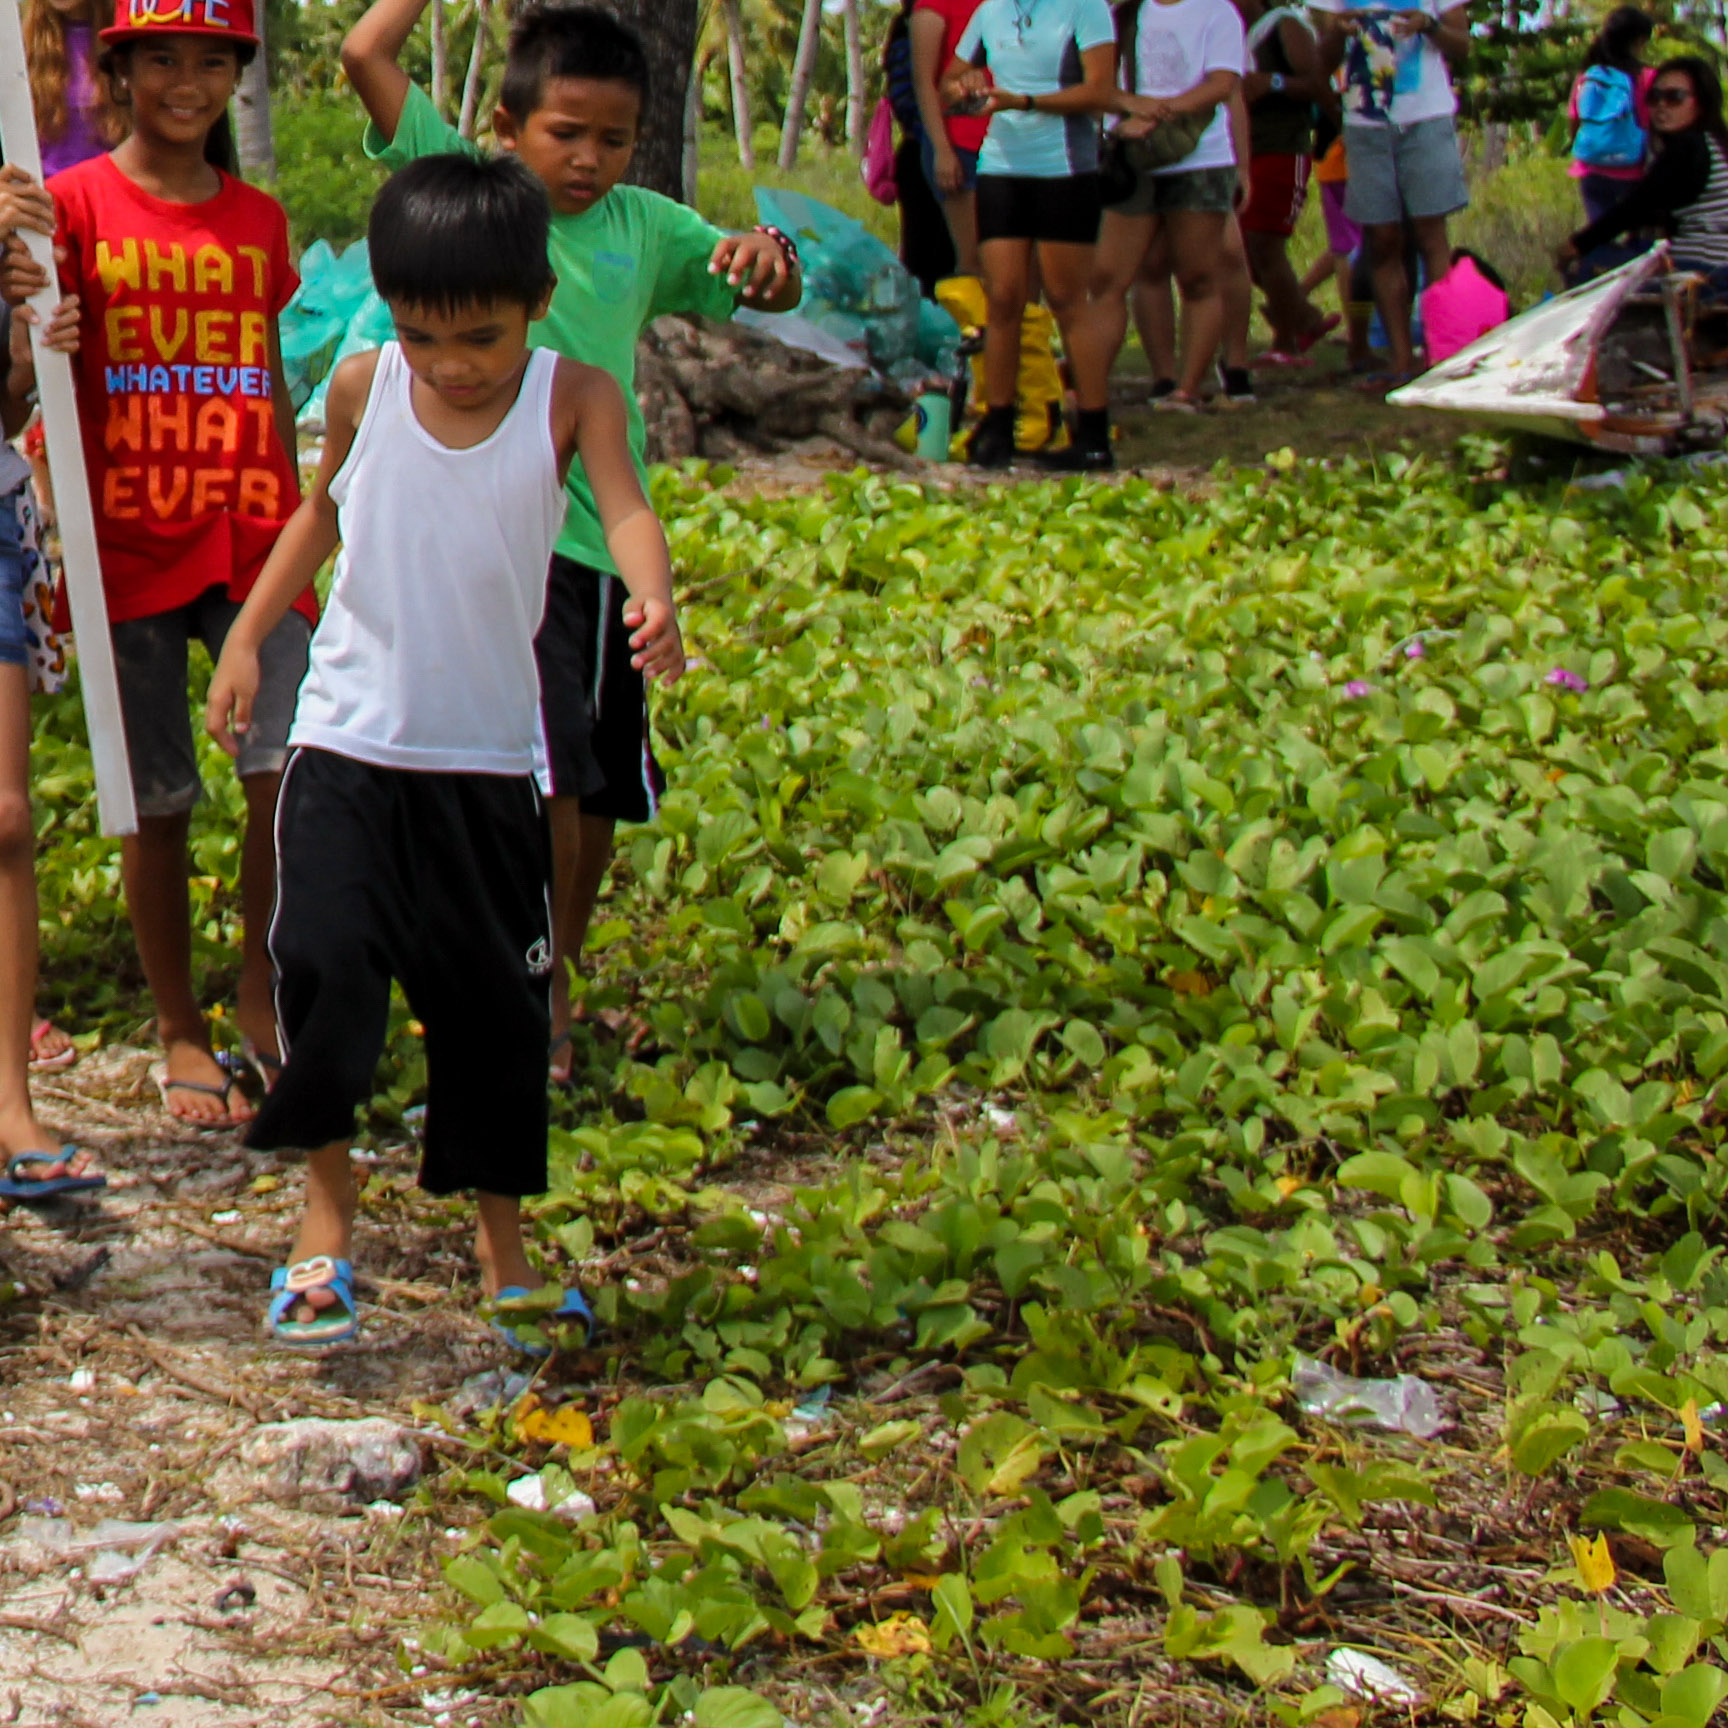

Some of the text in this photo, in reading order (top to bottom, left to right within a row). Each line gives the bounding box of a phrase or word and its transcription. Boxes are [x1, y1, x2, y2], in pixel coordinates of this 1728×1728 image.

[96, 237, 268, 298] WHAT
[105, 304, 269, 365] EVER
[104, 394, 273, 456] WHAT
[103, 465, 280, 521] EVER
